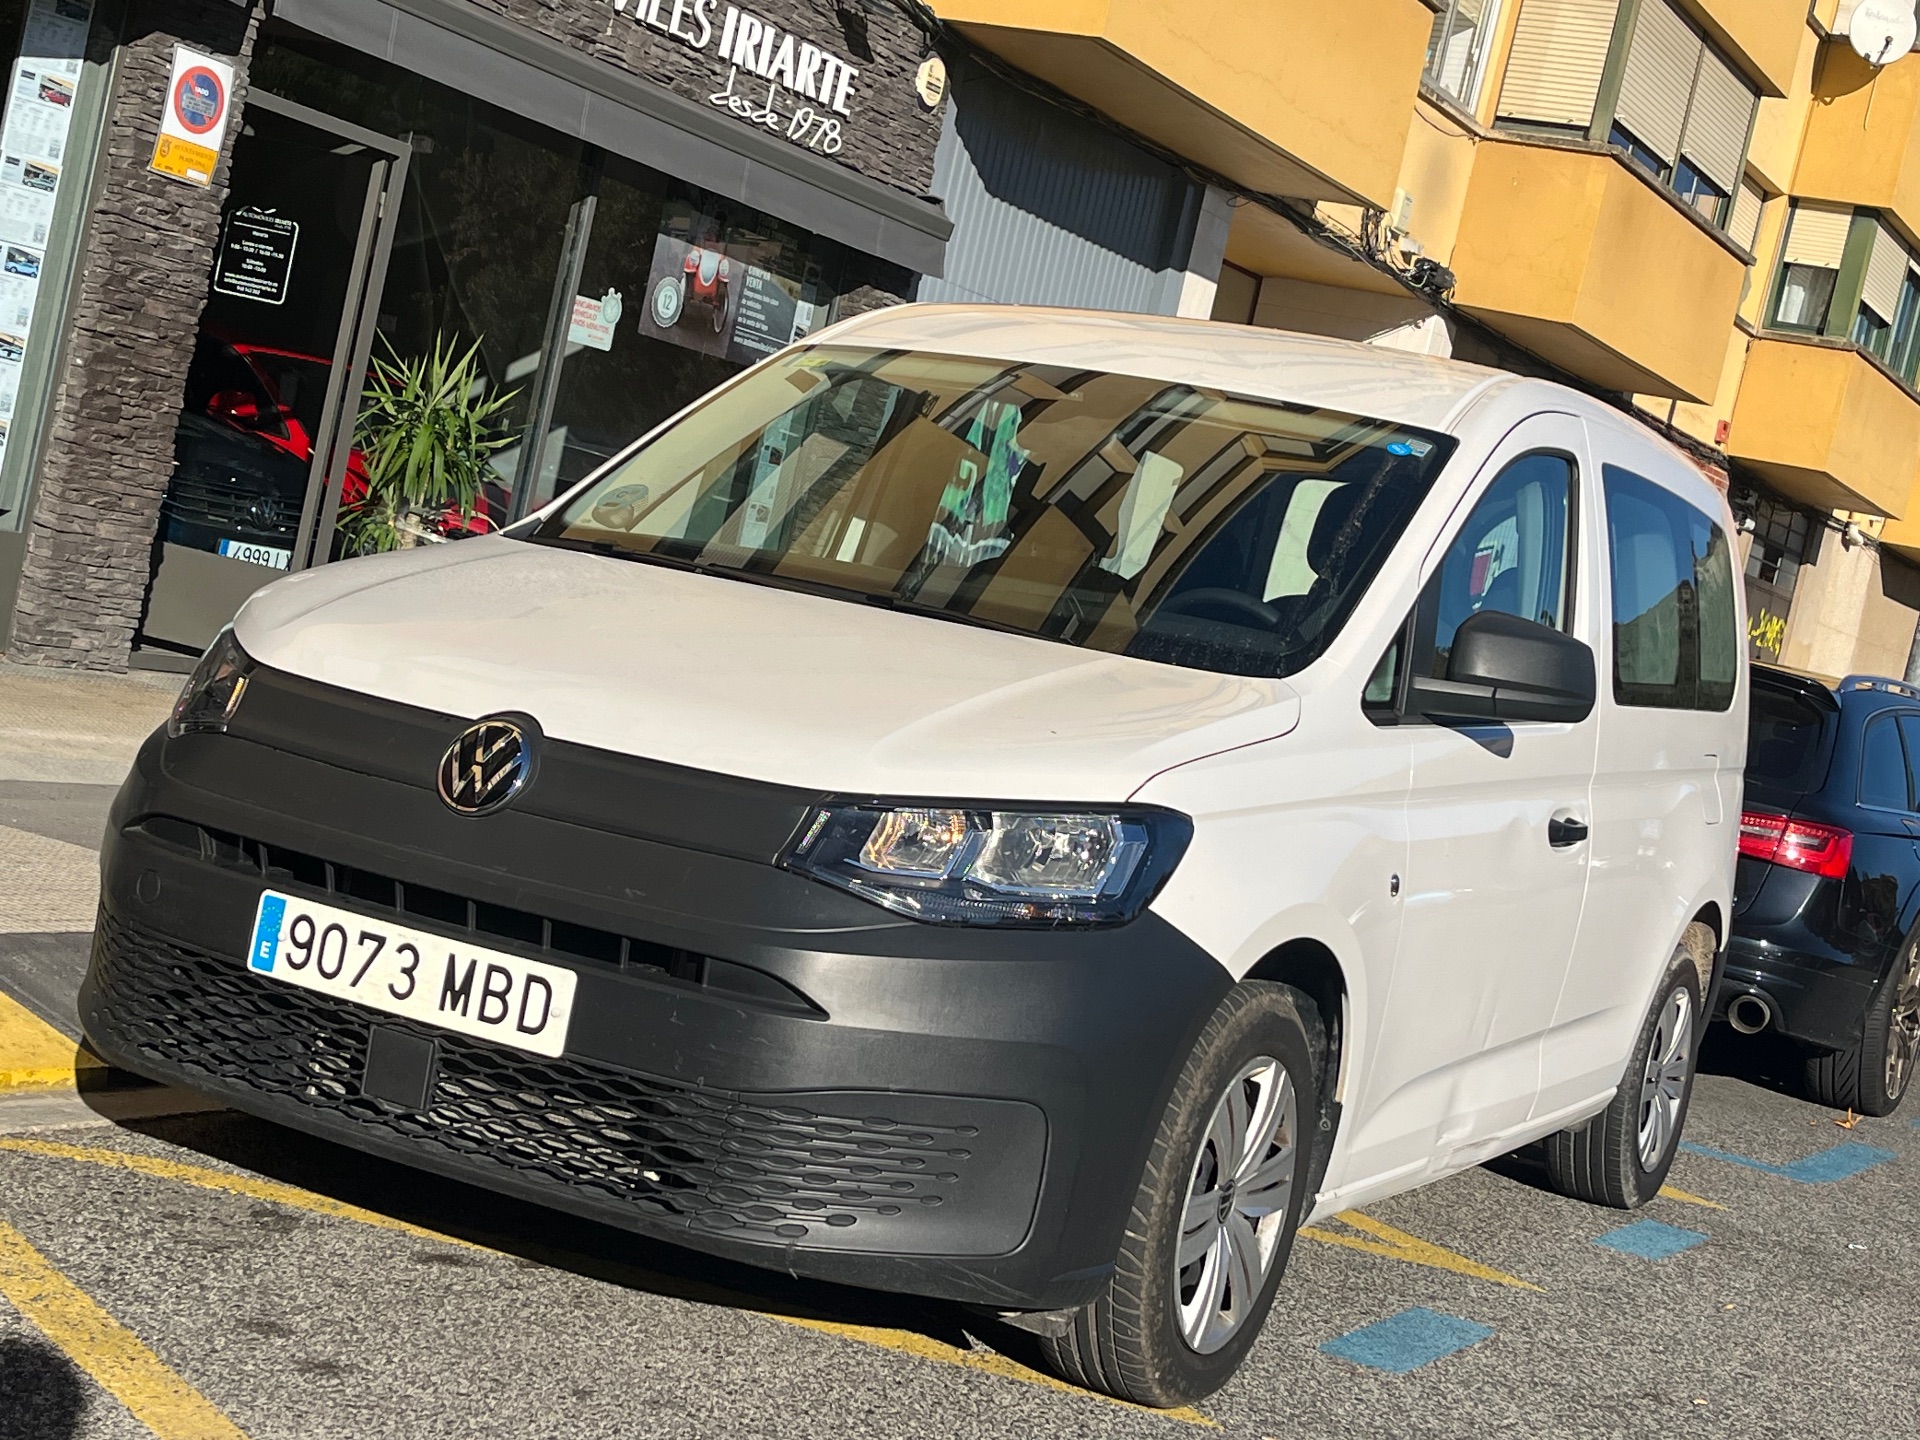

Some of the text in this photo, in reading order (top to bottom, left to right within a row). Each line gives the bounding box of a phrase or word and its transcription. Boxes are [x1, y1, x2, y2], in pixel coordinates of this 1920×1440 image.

[613, 0, 859, 117] LES IRIARTE
[709, 66, 842, 153] desde 1978
[662, 293, 673, 310] 12
[746, 275, 763, 290] VENTA
[259, 913, 552, 1036] E 9073 MBD
